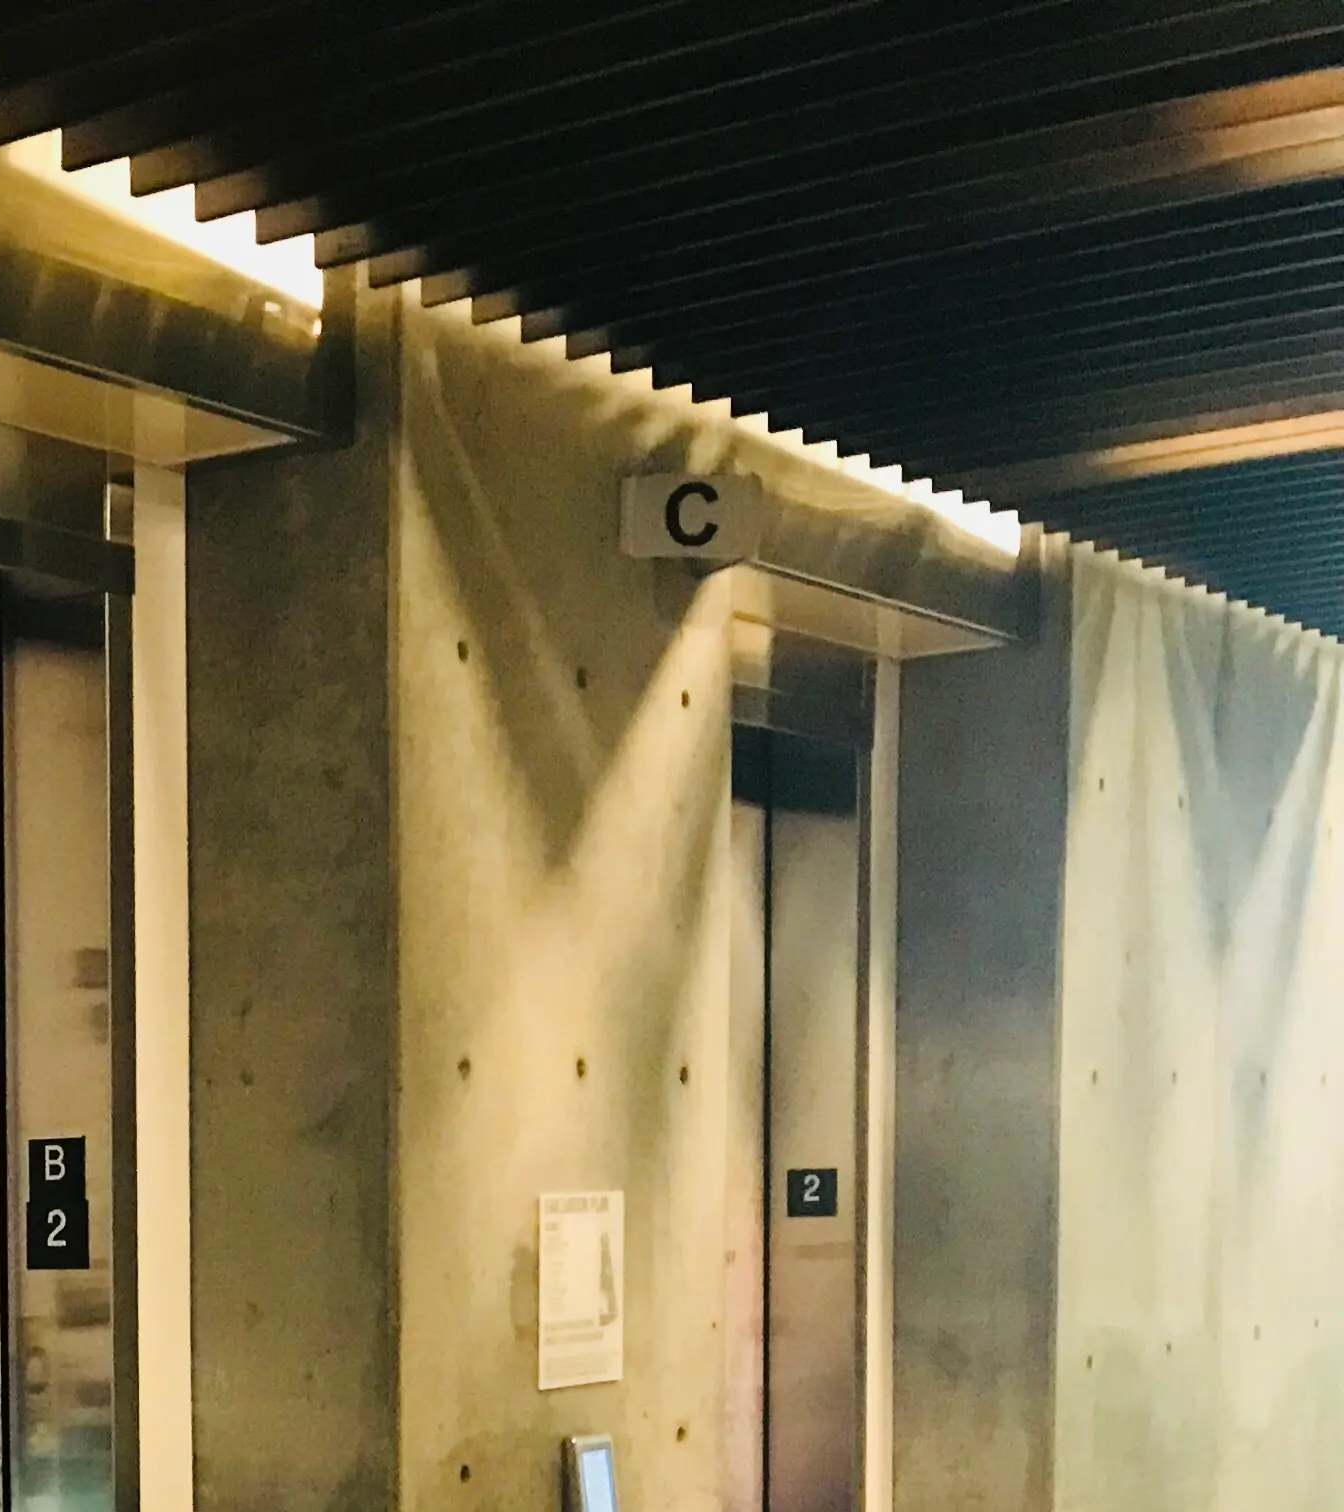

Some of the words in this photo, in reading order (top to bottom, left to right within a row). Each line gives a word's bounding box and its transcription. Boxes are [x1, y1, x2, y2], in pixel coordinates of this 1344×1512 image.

[666, 481, 718, 546] C
[44, 1144, 66, 1181] B
[803, 1174, 821, 1202] 2
[47, 1208, 67, 1247] 2
